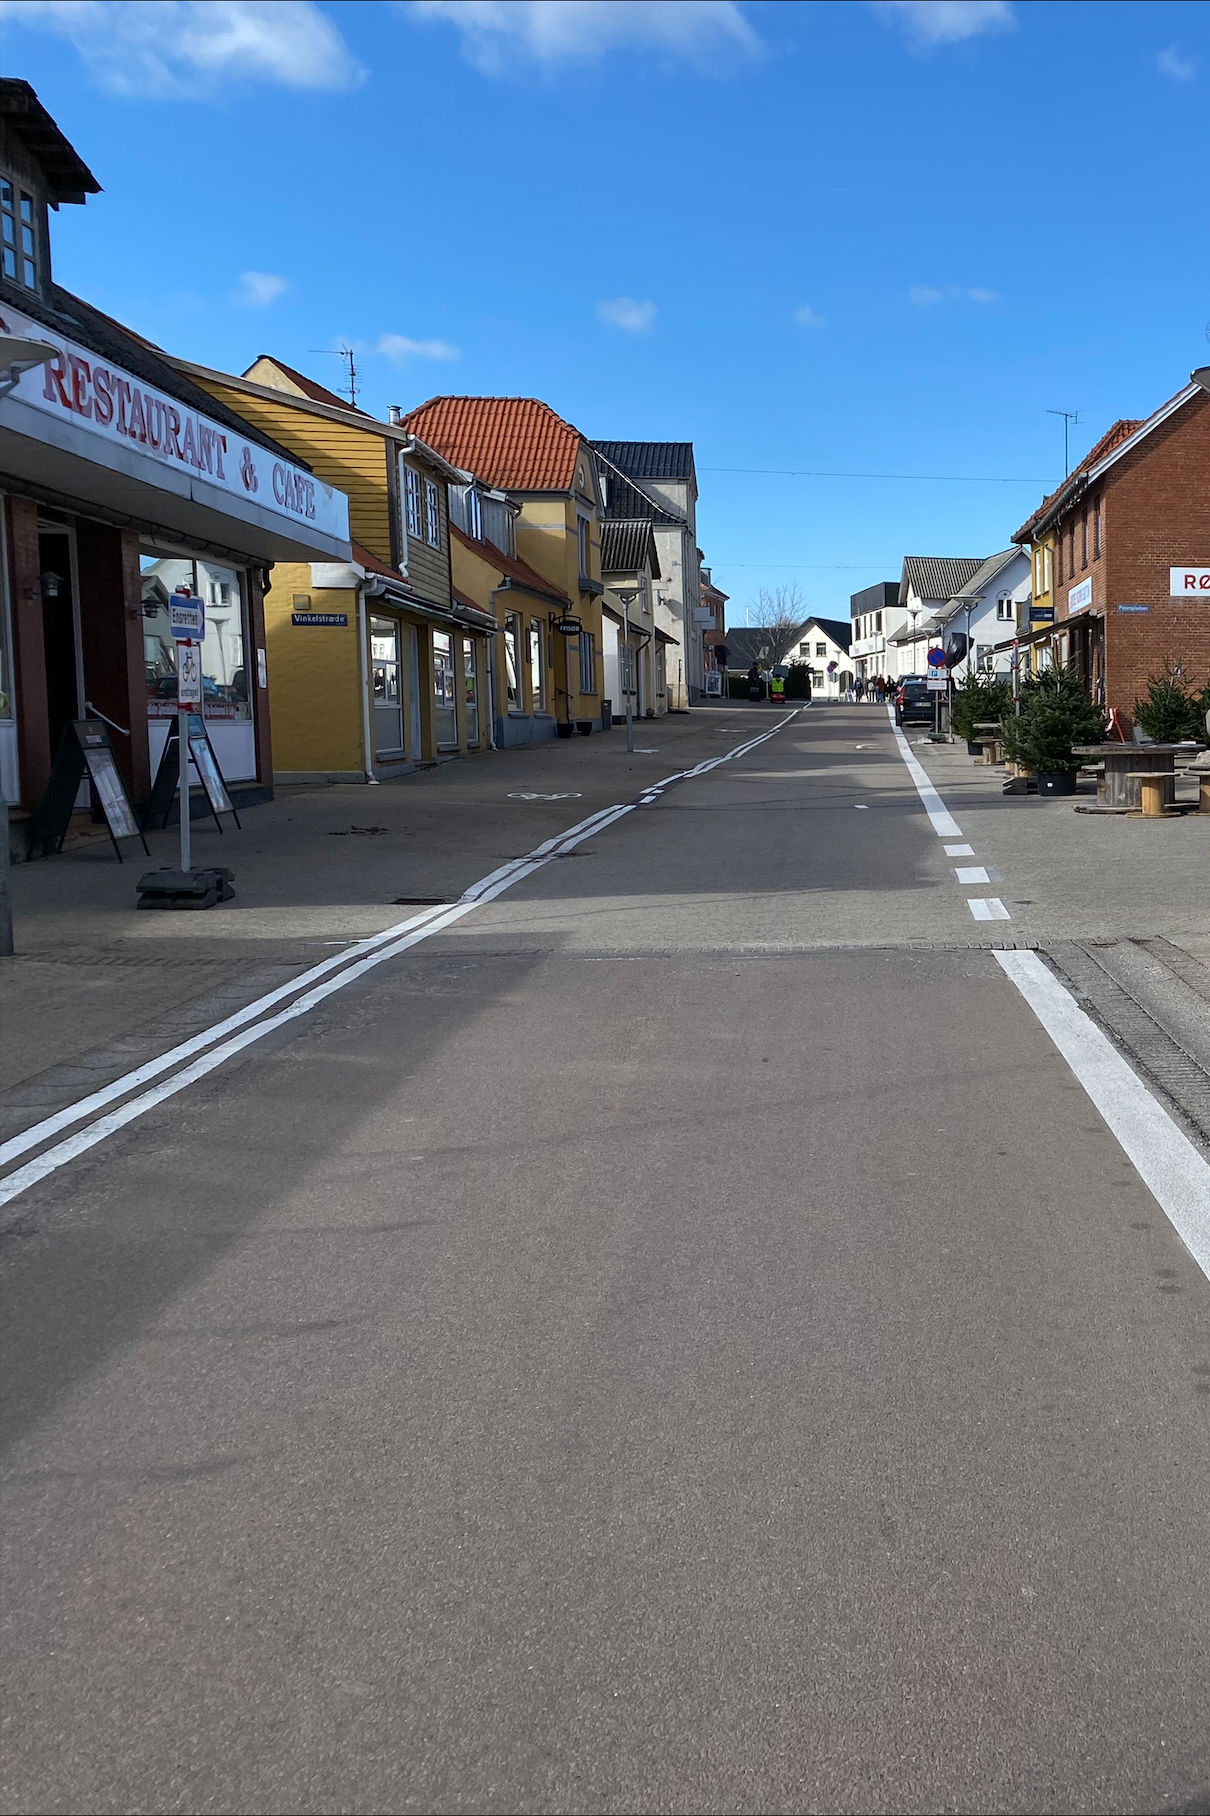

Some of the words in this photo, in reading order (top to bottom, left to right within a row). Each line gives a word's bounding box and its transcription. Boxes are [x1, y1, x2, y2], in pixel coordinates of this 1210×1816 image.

[42, 340, 227, 481] RESTAURANT
[241, 446, 259, 493] &
[272, 462, 316, 520] CAFE
[172, 608, 198, 626] Ensrettet
[294, 614, 345, 623] Vinkelstræde
